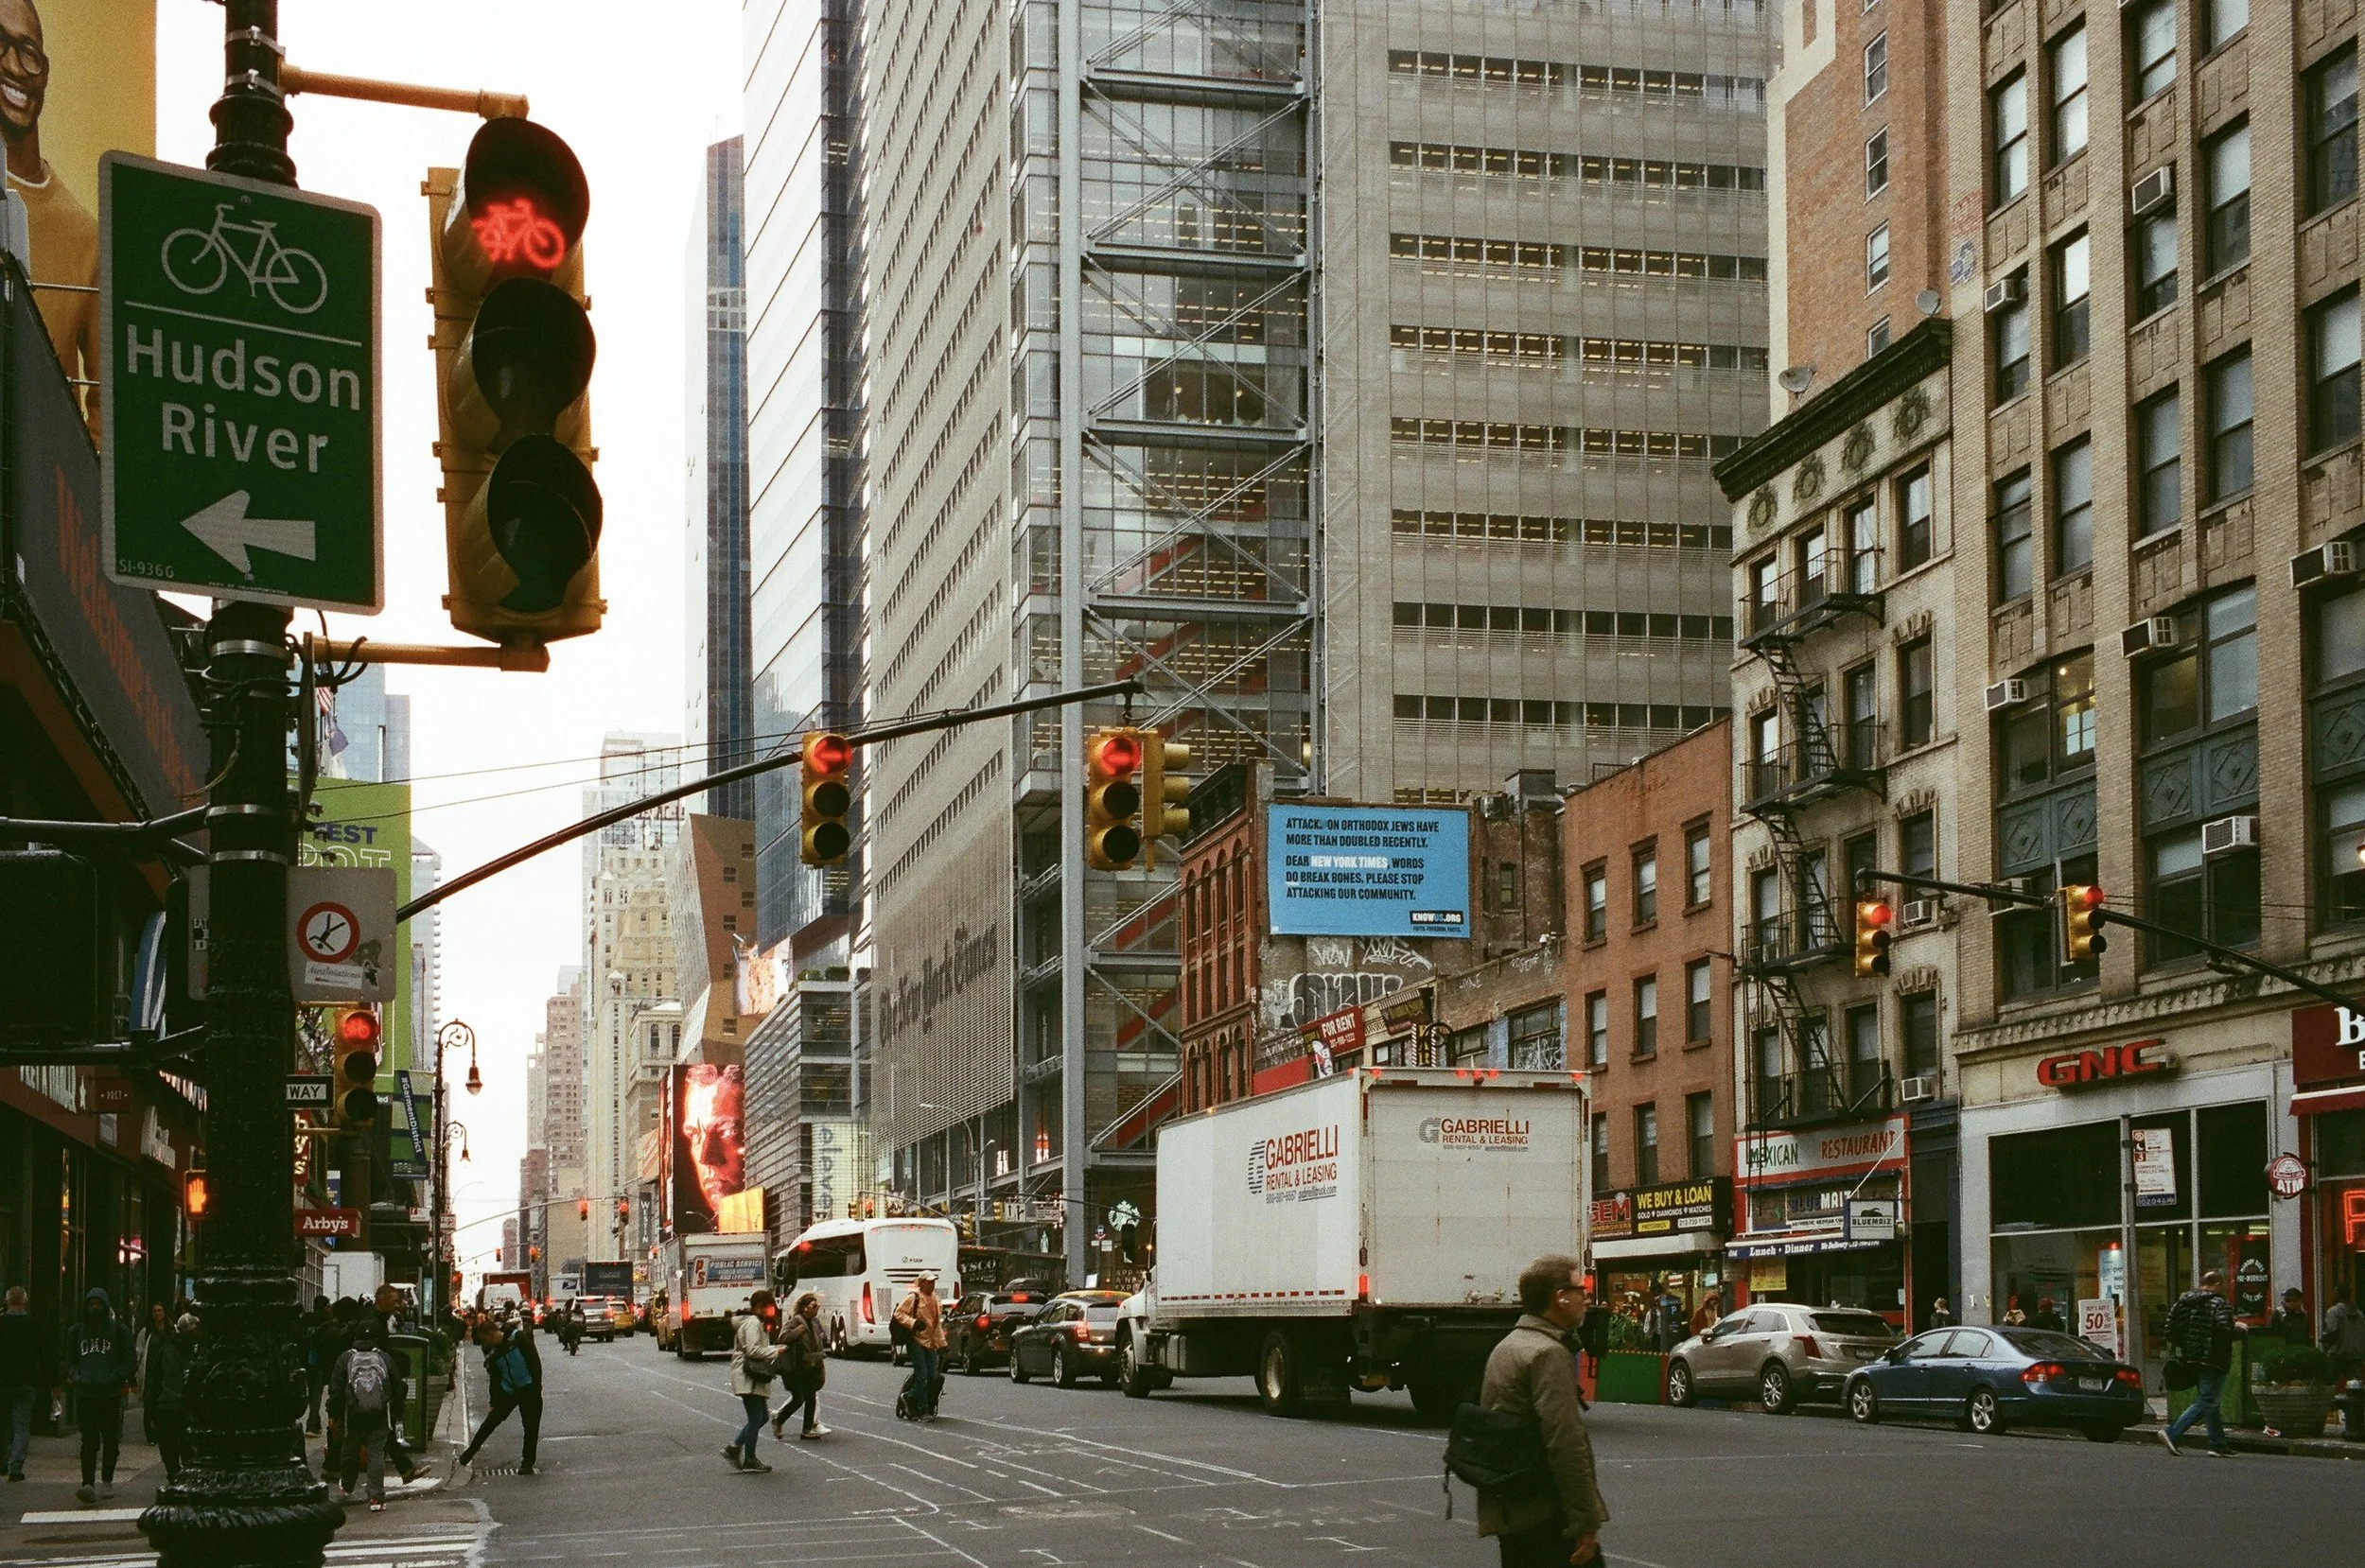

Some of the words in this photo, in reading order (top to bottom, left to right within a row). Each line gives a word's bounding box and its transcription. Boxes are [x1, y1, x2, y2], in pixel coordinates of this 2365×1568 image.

[127, 324, 360, 410] Hudson
[162, 401, 328, 473] River
[119, 560, 174, 579] SI-936G
[1327, 819, 1340, 830] ON
[1341, 820, 1389, 831] ORTHODOX
[1391, 821, 1414, 831] JEWS
[1417, 821, 1439, 832] HAVE
[1287, 834, 1312, 845] MORE
[1314, 835, 1338, 846] THAN
[1340, 836, 1380, 847] DOUBLED
[1382, 837, 1428, 848] RECENTLY.
[1287, 855, 1309, 866] DEAR
[1311, 856, 1331, 867] NEW
[1333, 856, 1358, 868] YORK
[1358, 857, 1390, 870] TIMES,
[1393, 858, 1424, 868] WORDS
[1287, 871, 1299, 882] DO
[1301, 872, 1330, 883] BREAK
[1332, 873, 1364, 884] BONES.
[1366, 873, 1399, 884] PLEASE
[1401, 874, 1424, 885] STOP
[1287, 887, 1336, 898] ATTACKING
[1338, 888, 1357, 899] OUR
[1358, 889, 1415, 900] COMMUNITY.
[1412, 913, 1461, 923] KNOWUS.ORG
[1322, 1021, 1336, 1038] FOR
[1336, 1013, 1356, 1033] RENT
[2036, 1038, 2166, 1089] GNC
[289, 1085, 321, 1098] WAY
[401, 1077, 422, 1153] #GarmentDistrict
[1441, 1118, 1529, 1135] GABRIELLI
[1266, 1124, 1338, 1170] GABRIELLI
[1443, 1135, 1476, 1143] RENTAL
[1480, 1136, 1486, 1144] &
[1489, 1136, 1528, 1144] LEASING
[1750, 1142, 1798, 1169] MEXICAN
[1821, 1130, 1896, 1159] RESTAURANT
[819, 1126, 843, 1210] eleve
[1266, 1171, 1292, 1191] RENTAL
[1294, 1169, 1301, 1187] &
[1303, 1162, 1337, 1185] LEASING
[2277, 1178, 2304, 1193] ATM
[1637, 1192, 1653, 1210] WE
[1655, 1190, 1673, 1208] BUY
[1674, 1189, 1683, 1205] &
[1684, 1185, 1712, 1205] LOAN
[1637, 1211, 1651, 1220] GOLD
[1656, 1208, 1682, 1217] DIAMONDS
[1689, 1205, 1712, 1213] WATCHES
[303, 1217, 348, 1235] Arby's
[640, 1200, 650, 1244] WESTIN
[1749, 1245, 1776, 1257] Lunch
[1785, 1243, 1814, 1254] Dinner
[960, 1259, 997, 1274] YSCO
